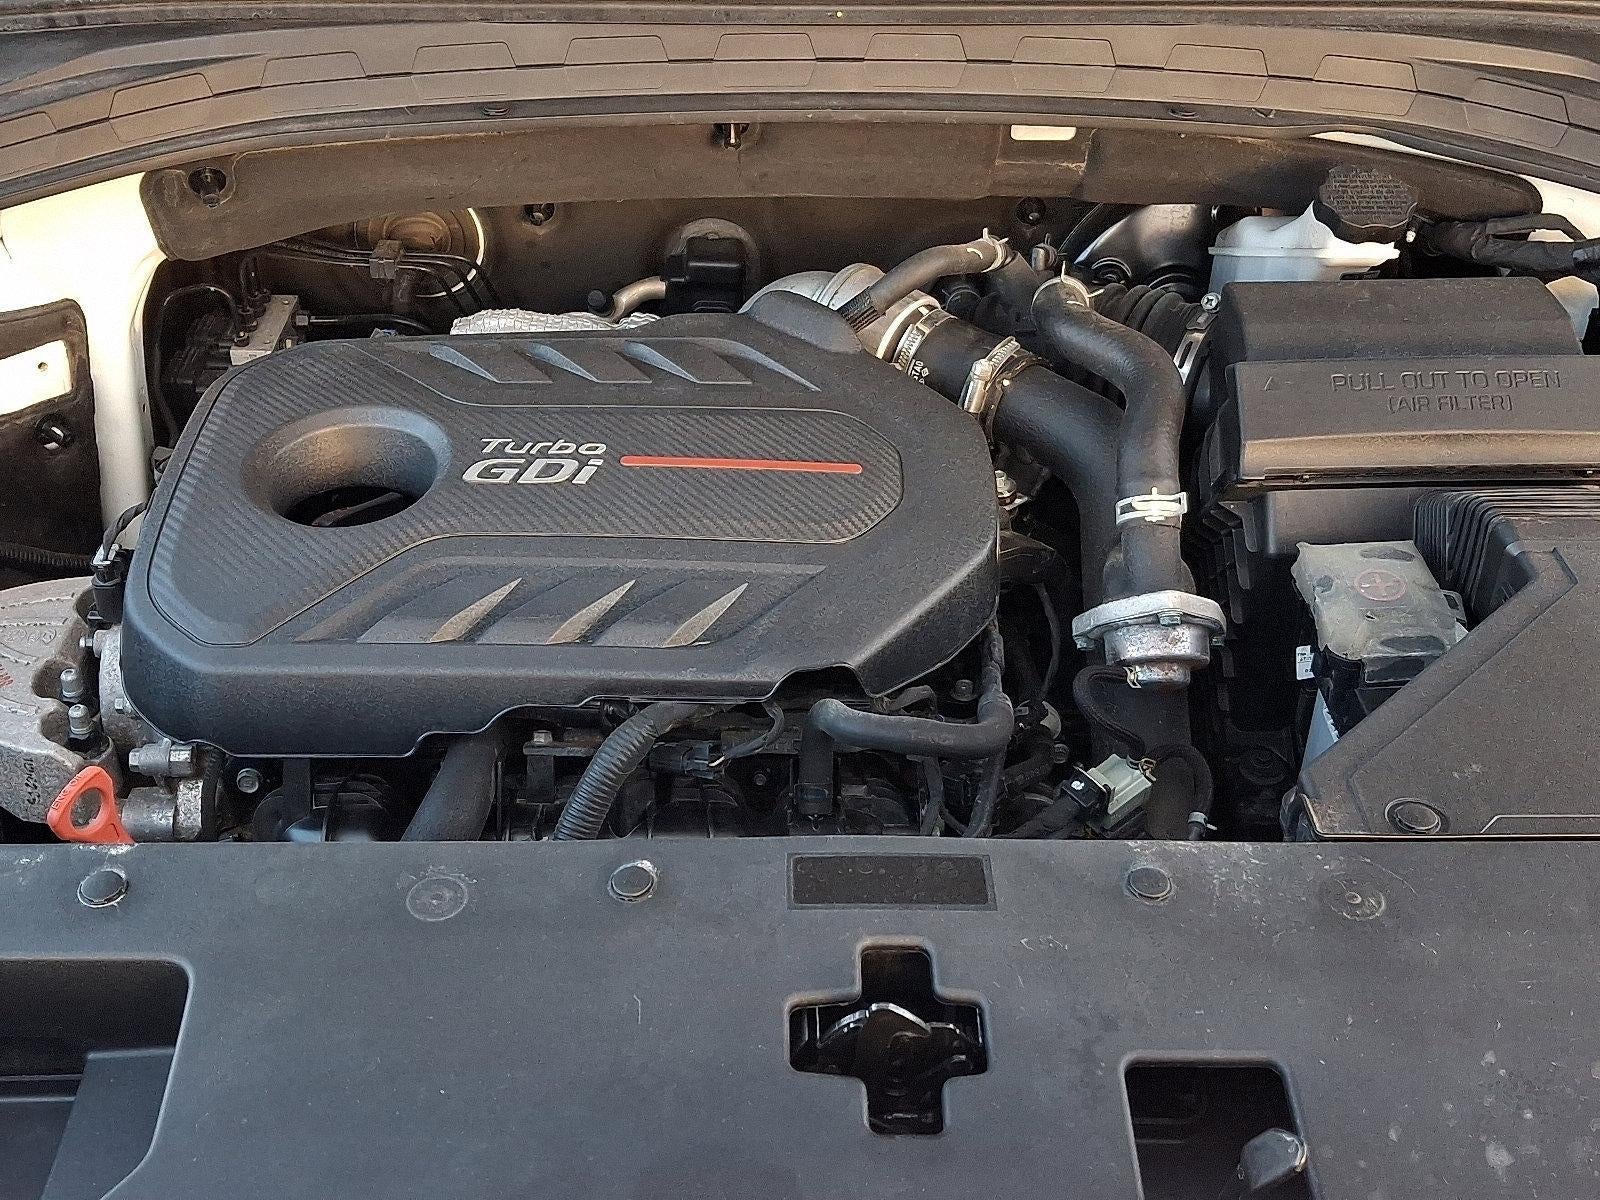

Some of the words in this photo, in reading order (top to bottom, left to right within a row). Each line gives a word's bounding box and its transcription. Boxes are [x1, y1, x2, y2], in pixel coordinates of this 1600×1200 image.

[1330, 372, 1396, 391] PULL
[1400, 370, 1450, 390] OUT
[1455, 369, 1489, 390] TO
[1494, 369, 1562, 389] OPEN
[480, 437, 608, 455] Turbo
[461, 457, 605, 485] GDi
